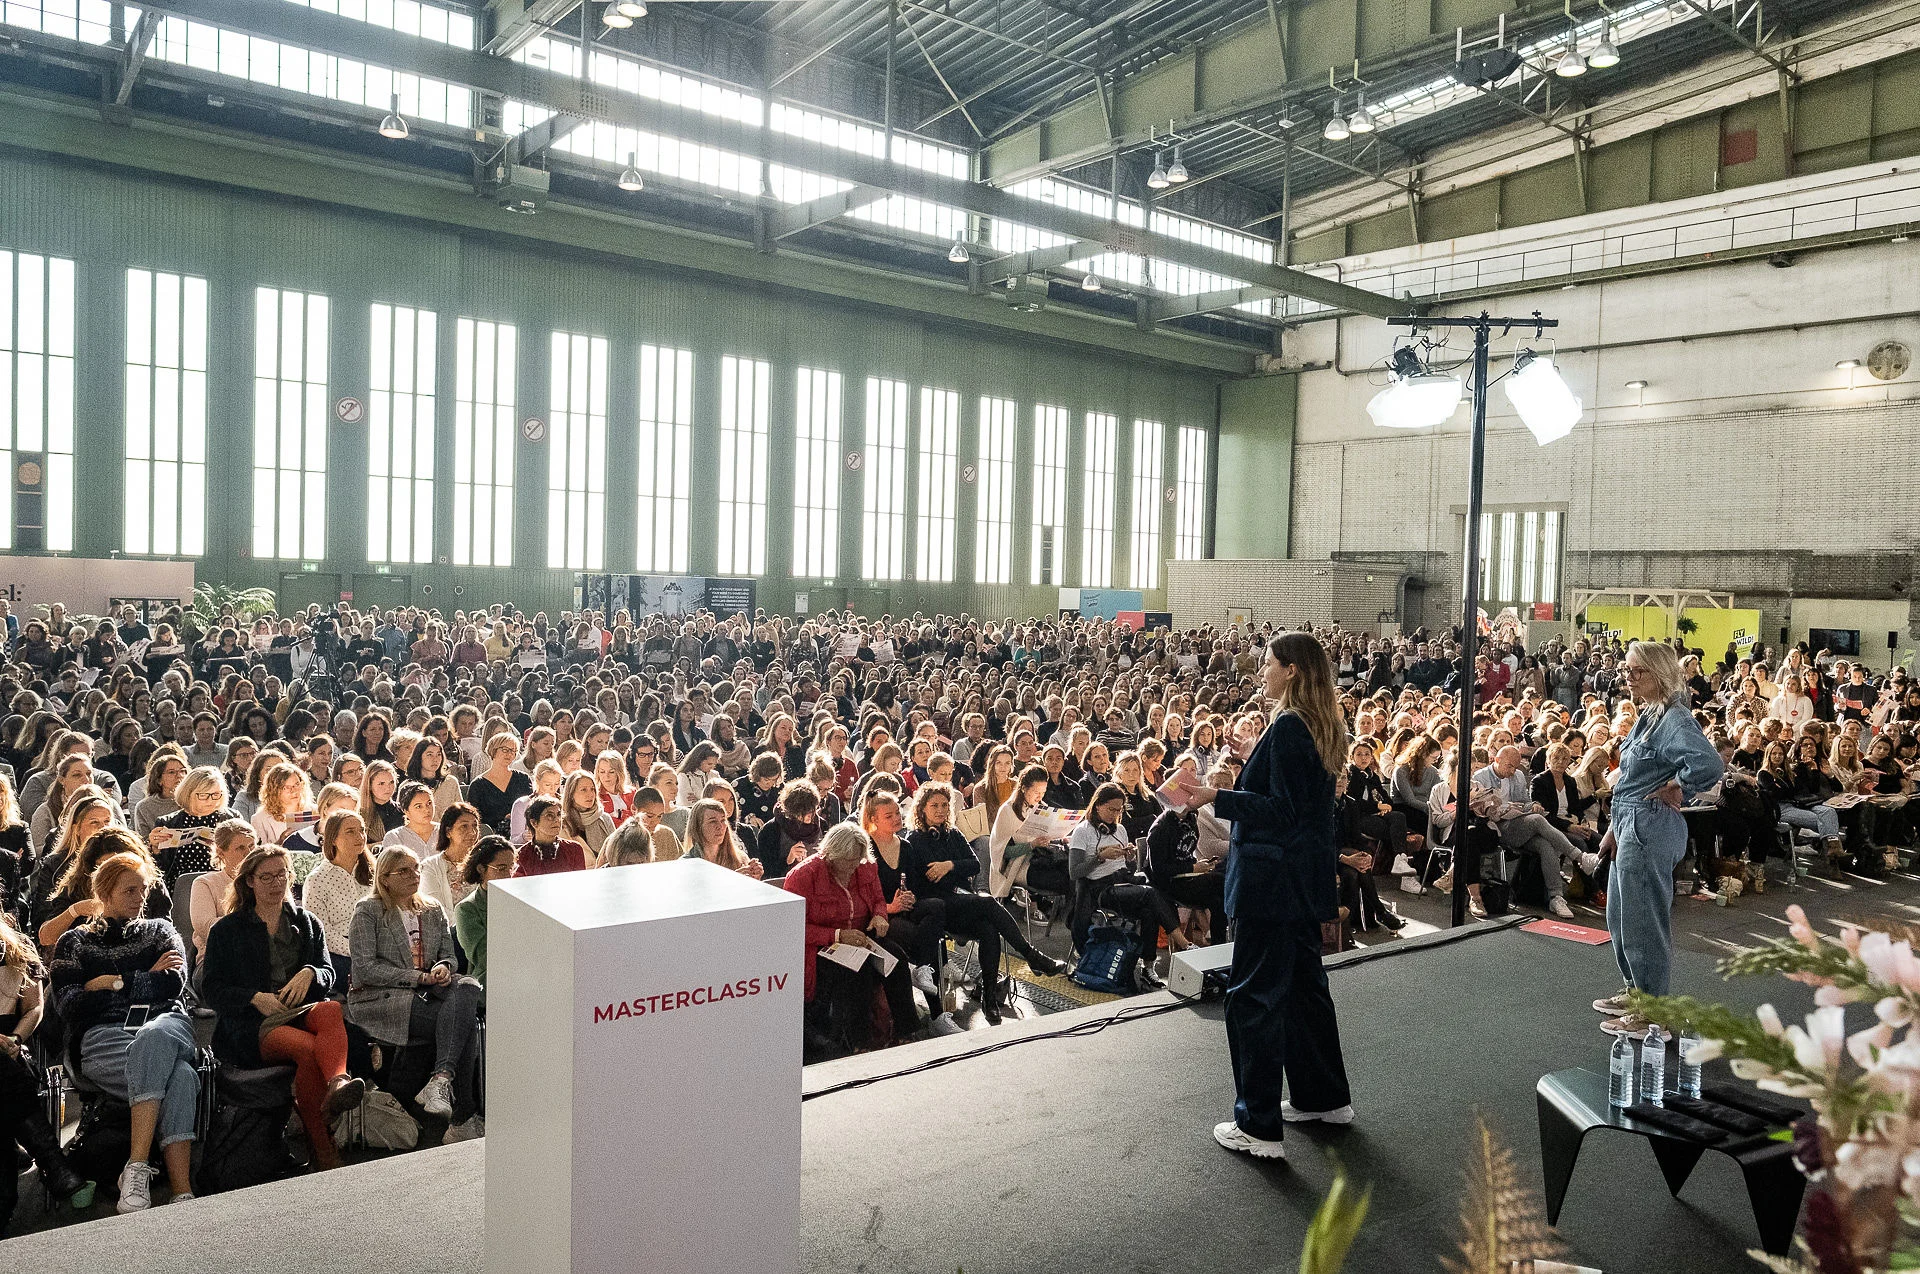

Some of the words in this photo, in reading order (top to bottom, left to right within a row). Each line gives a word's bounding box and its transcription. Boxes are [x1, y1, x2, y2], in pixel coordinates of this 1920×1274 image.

[1734, 629, 1745, 639] FLY
[1737, 636, 1754, 645] WILD!
[594, 978, 761, 1024] MASTERCLASS
[767, 973, 789, 992] IV
